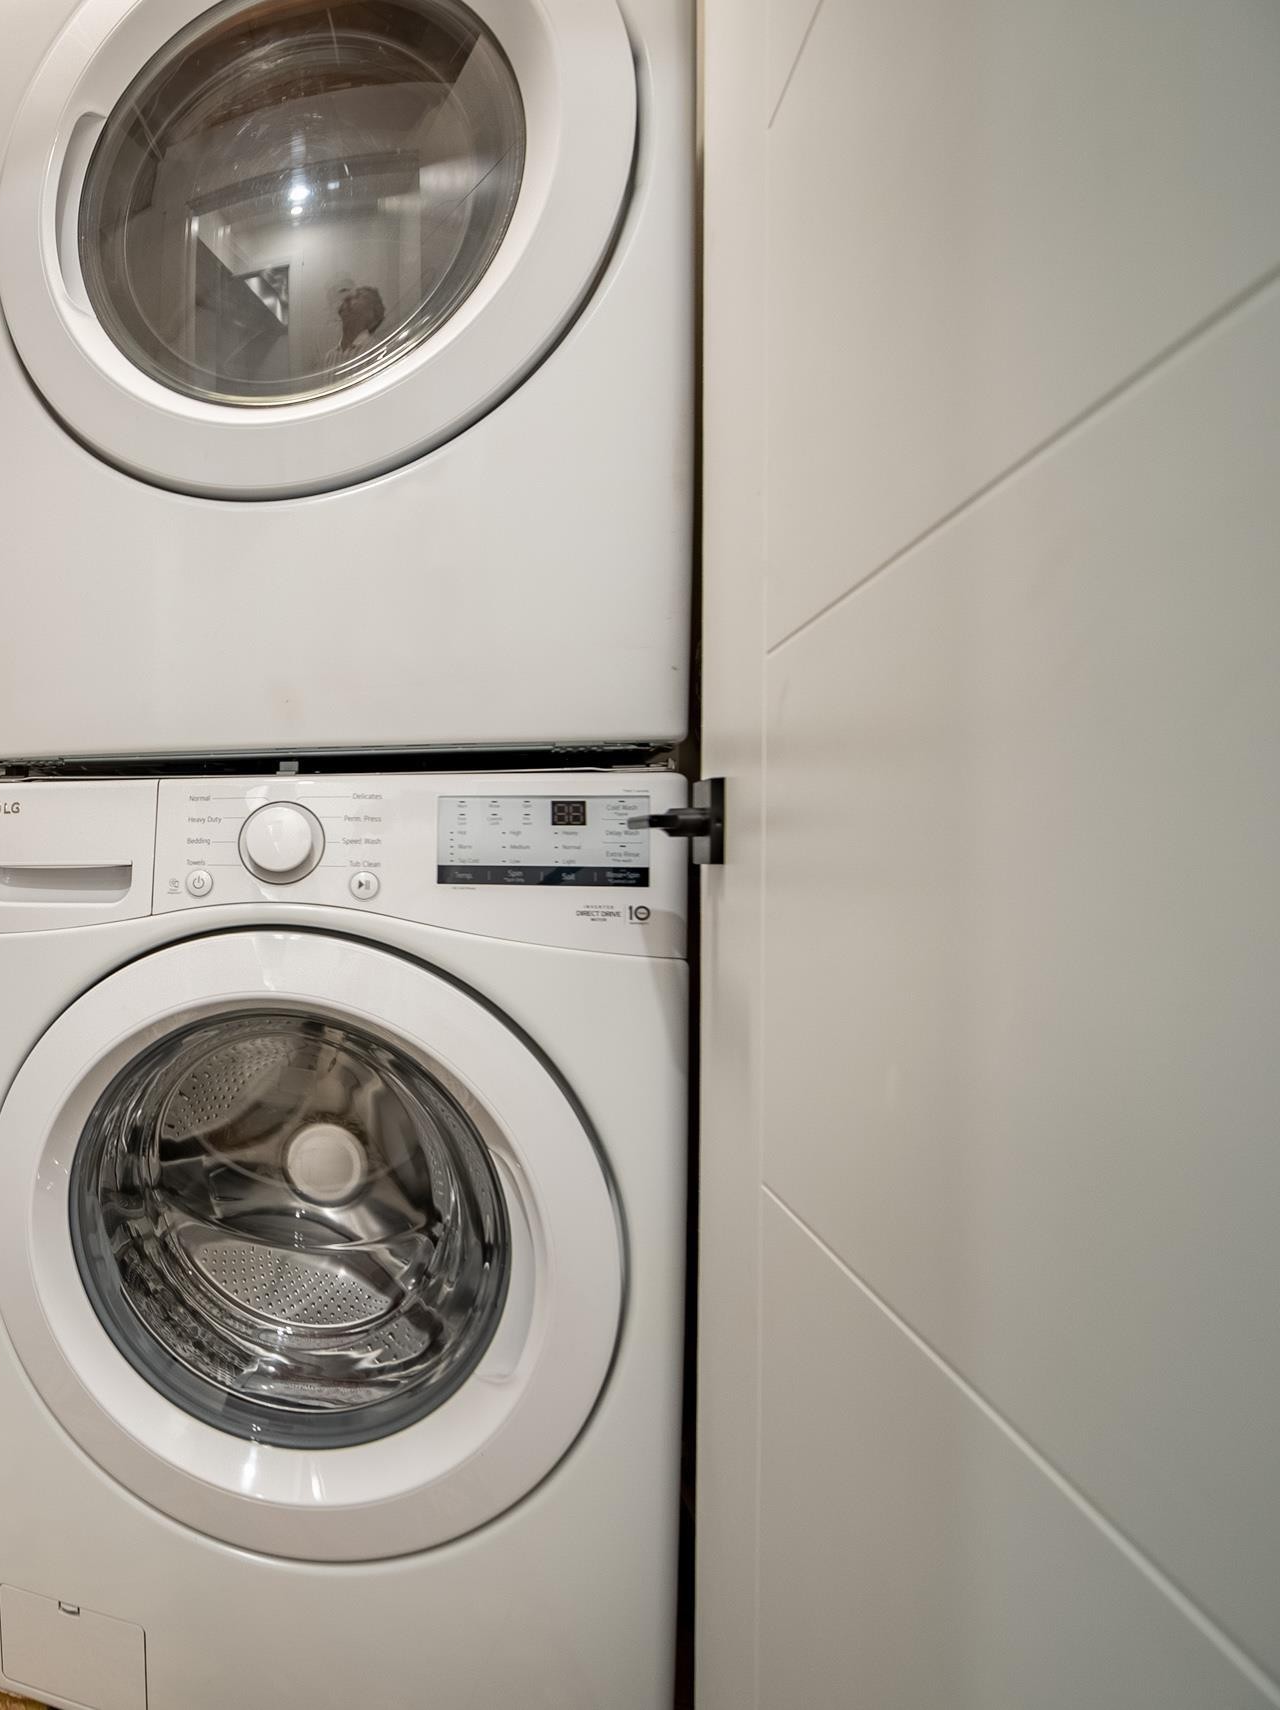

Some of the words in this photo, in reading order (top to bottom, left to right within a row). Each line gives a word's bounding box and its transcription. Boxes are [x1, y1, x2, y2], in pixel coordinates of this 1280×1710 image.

[3, 802, 20, 814] LG
[188, 817, 206, 825] Heavy
[207, 815, 222, 824] Duty
